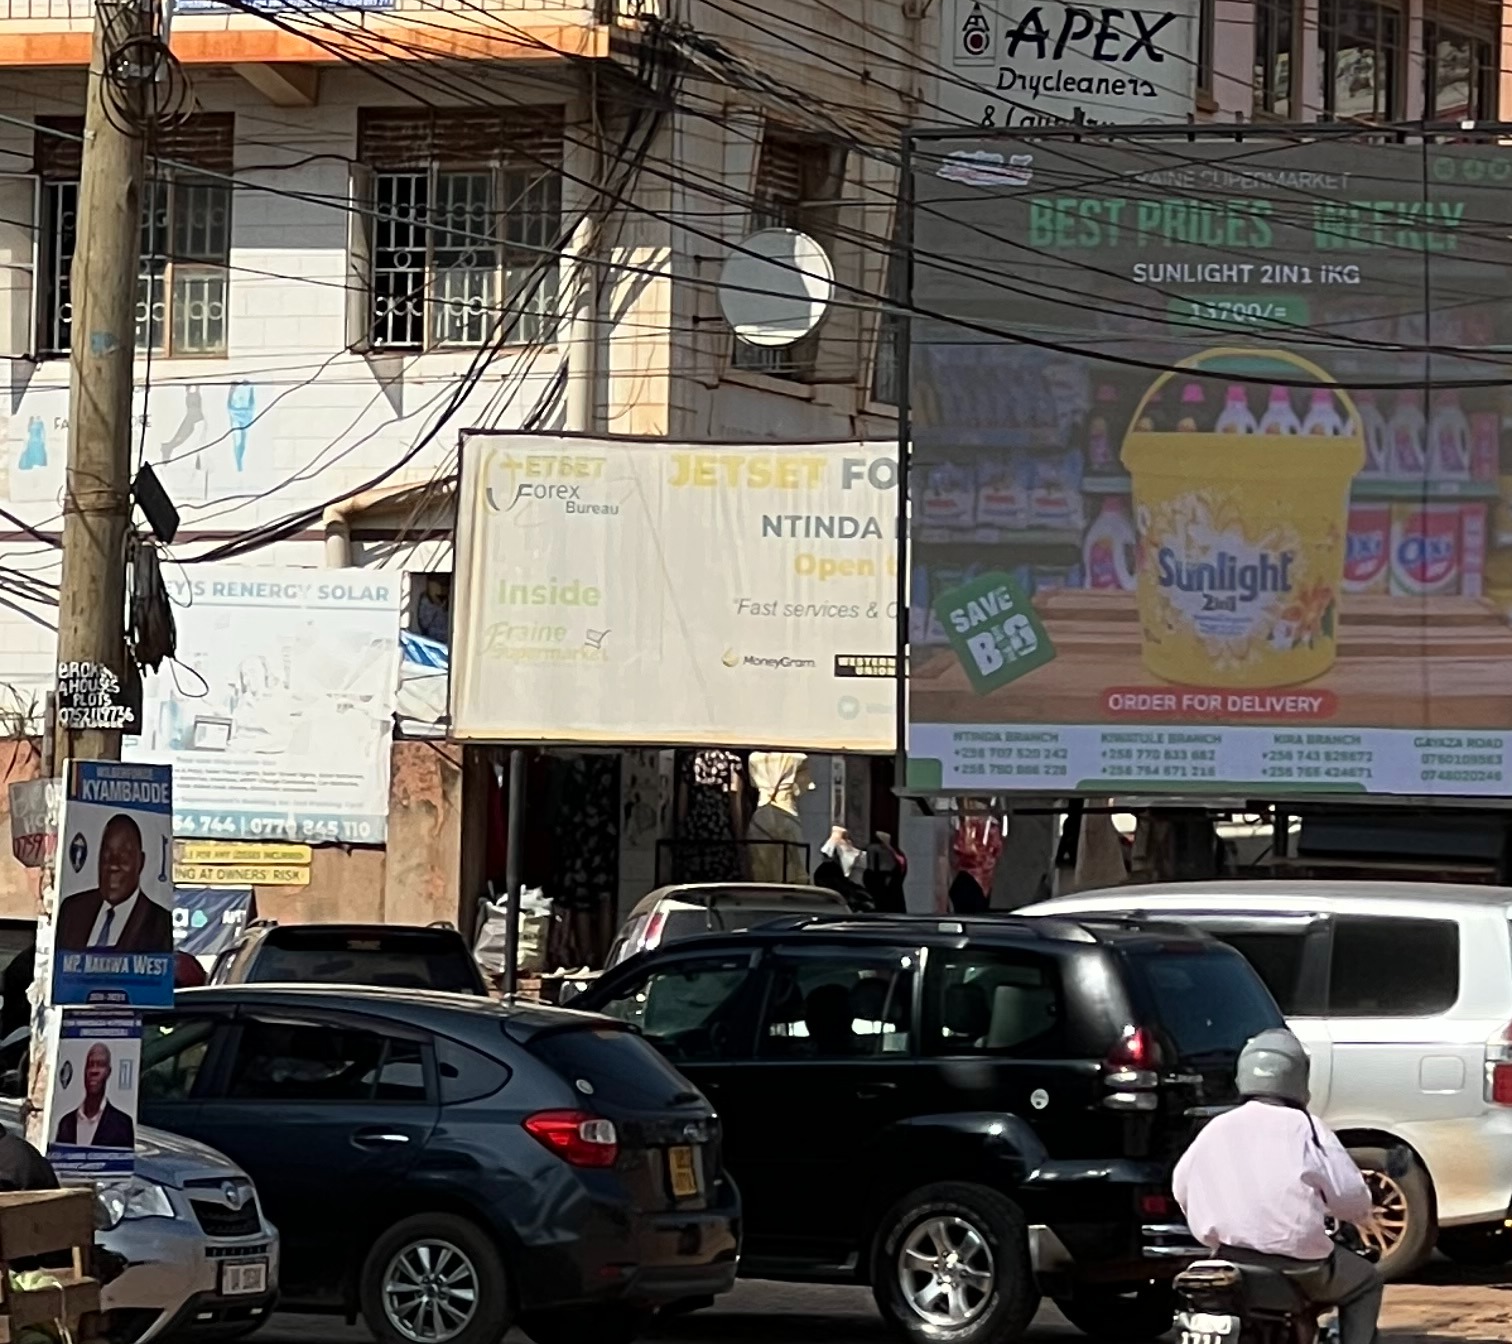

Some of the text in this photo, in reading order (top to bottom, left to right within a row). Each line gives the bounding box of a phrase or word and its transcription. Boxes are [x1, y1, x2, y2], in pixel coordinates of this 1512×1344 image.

[1005, 7, 1177, 62] APEX
[996, 67, 1158, 99] Drycleaners
[1030, 199, 1127, 247] BEST
[1137, 199, 1274, 248] PRICES
[1132, 263, 1253, 284] SUNLIGHT
[1260, 264, 1313, 284] 2IN1
[668, 455, 827, 490] JETSET
[565, 500, 620, 516] Bureau
[761, 515, 883, 539] NTINDA
[794, 556, 876, 581] Open
[1158, 547, 1294, 602] Sunlight
[318, 585, 389, 602] SOLAR
[498, 577, 601, 606] Inside
[783, 601, 860, 618] services
[866, 602, 879, 618] &
[949, 585, 1014, 633] SAVE
[743, 656, 816, 669] MoneyGram
[1108, 693, 1323, 713] ORDER FOR DELIVERY
[81, 779, 171, 804] KYAMBADDE
[200, 868, 214, 880] AT
[273, 869, 301, 881] RISK
